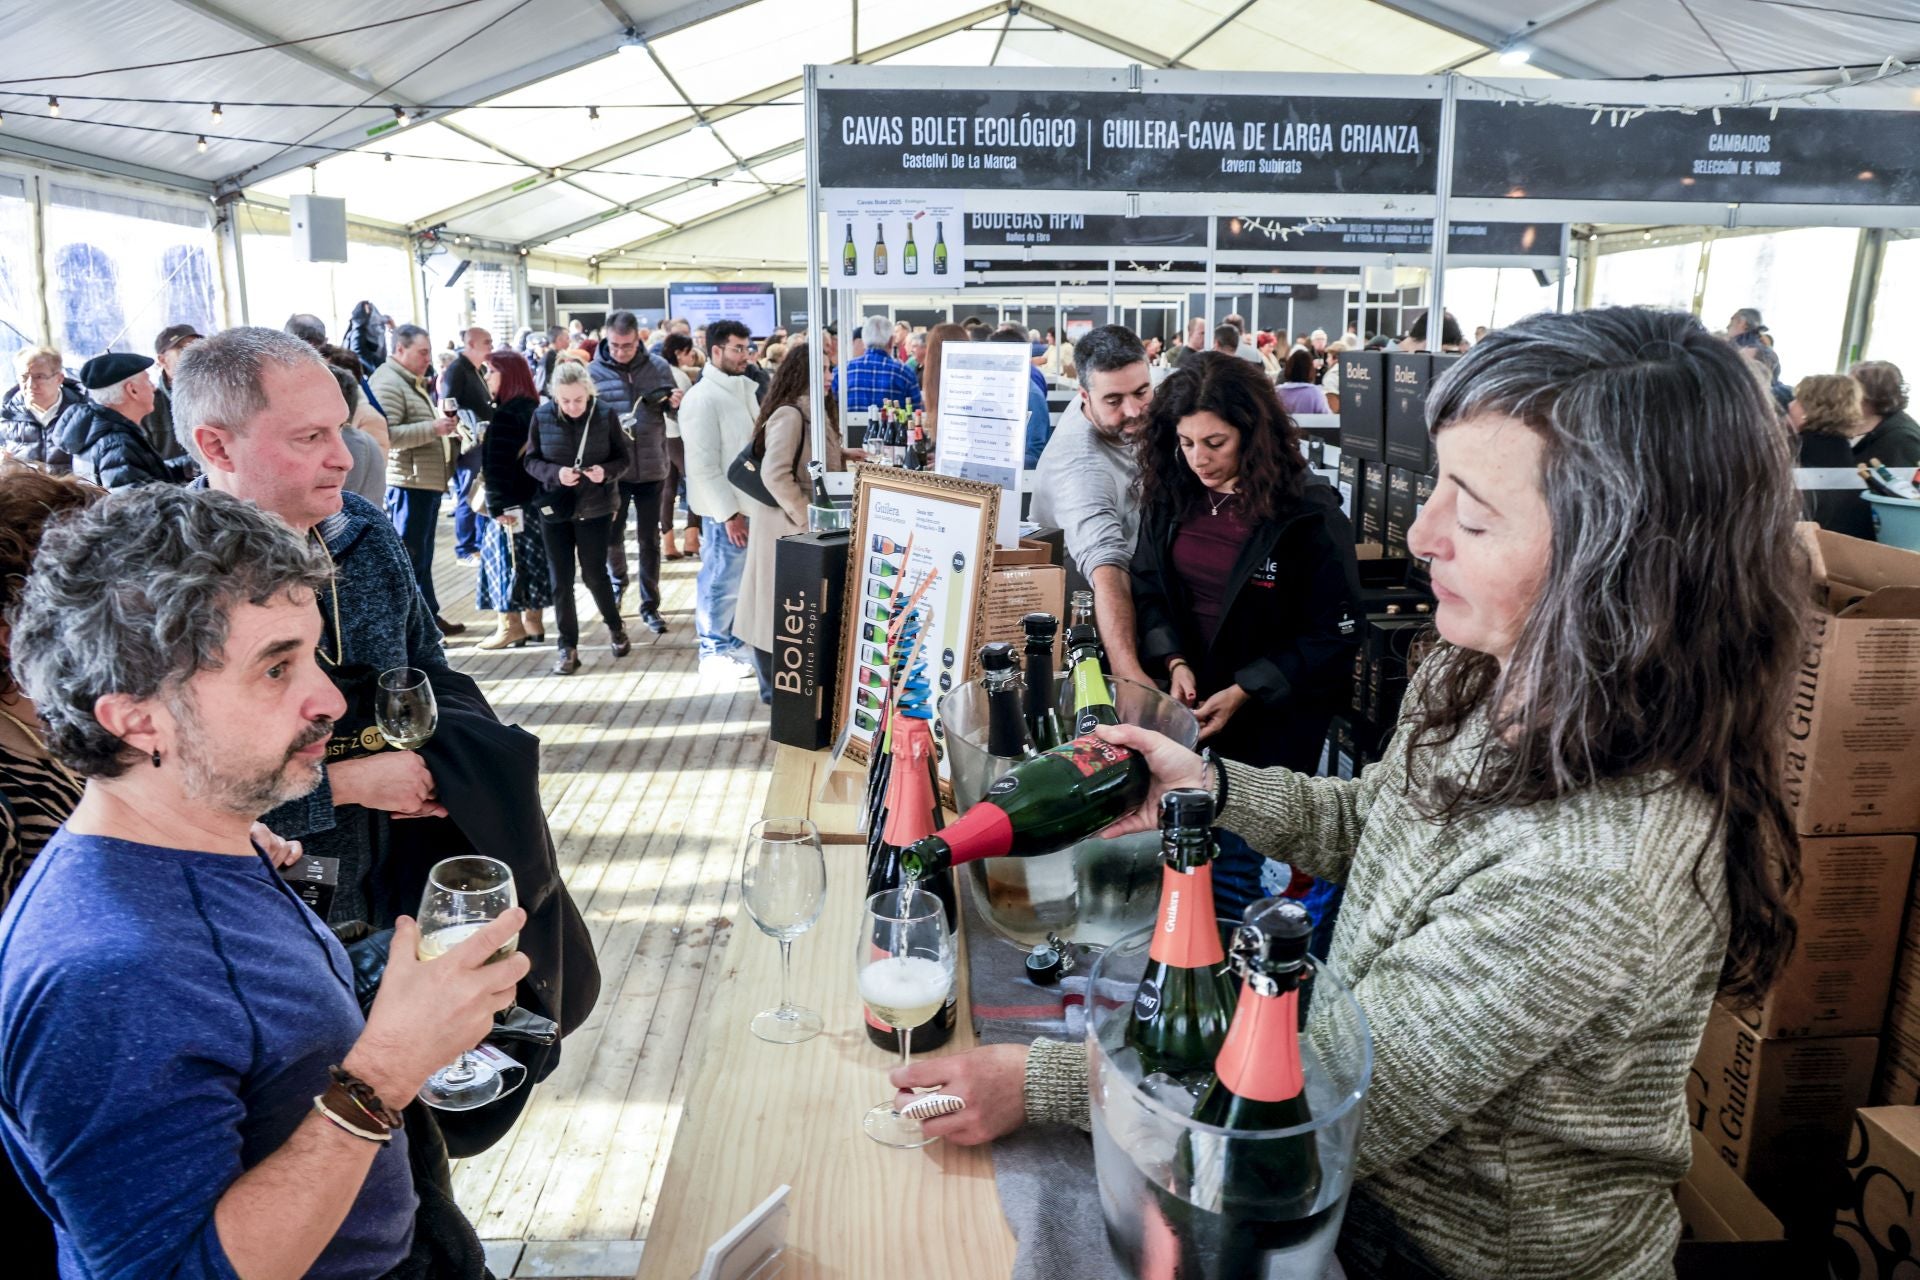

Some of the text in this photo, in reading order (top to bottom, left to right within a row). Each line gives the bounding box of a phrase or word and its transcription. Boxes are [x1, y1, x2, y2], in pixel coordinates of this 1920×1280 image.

[842, 112, 1076, 147] CAVAS BOLET ECOLÓGICO
[1102, 119, 1420, 153] GUILERA-CAVA DE LARGA CRIANZA
[1708, 133, 1771, 153] CAMBADOS
[902, 153, 1017, 169] Castellvi De La Marca
[1221, 157, 1302, 173] Lavern Subirats
[1693, 158, 1781, 175] SELECCIÓN DE VINOS
[972, 213, 1043, 230] BODEGAS
[775, 591, 805, 694] Bolet.
[1164, 890, 1180, 933] Guilera
[1718, 1031, 1755, 1141] Guilera
